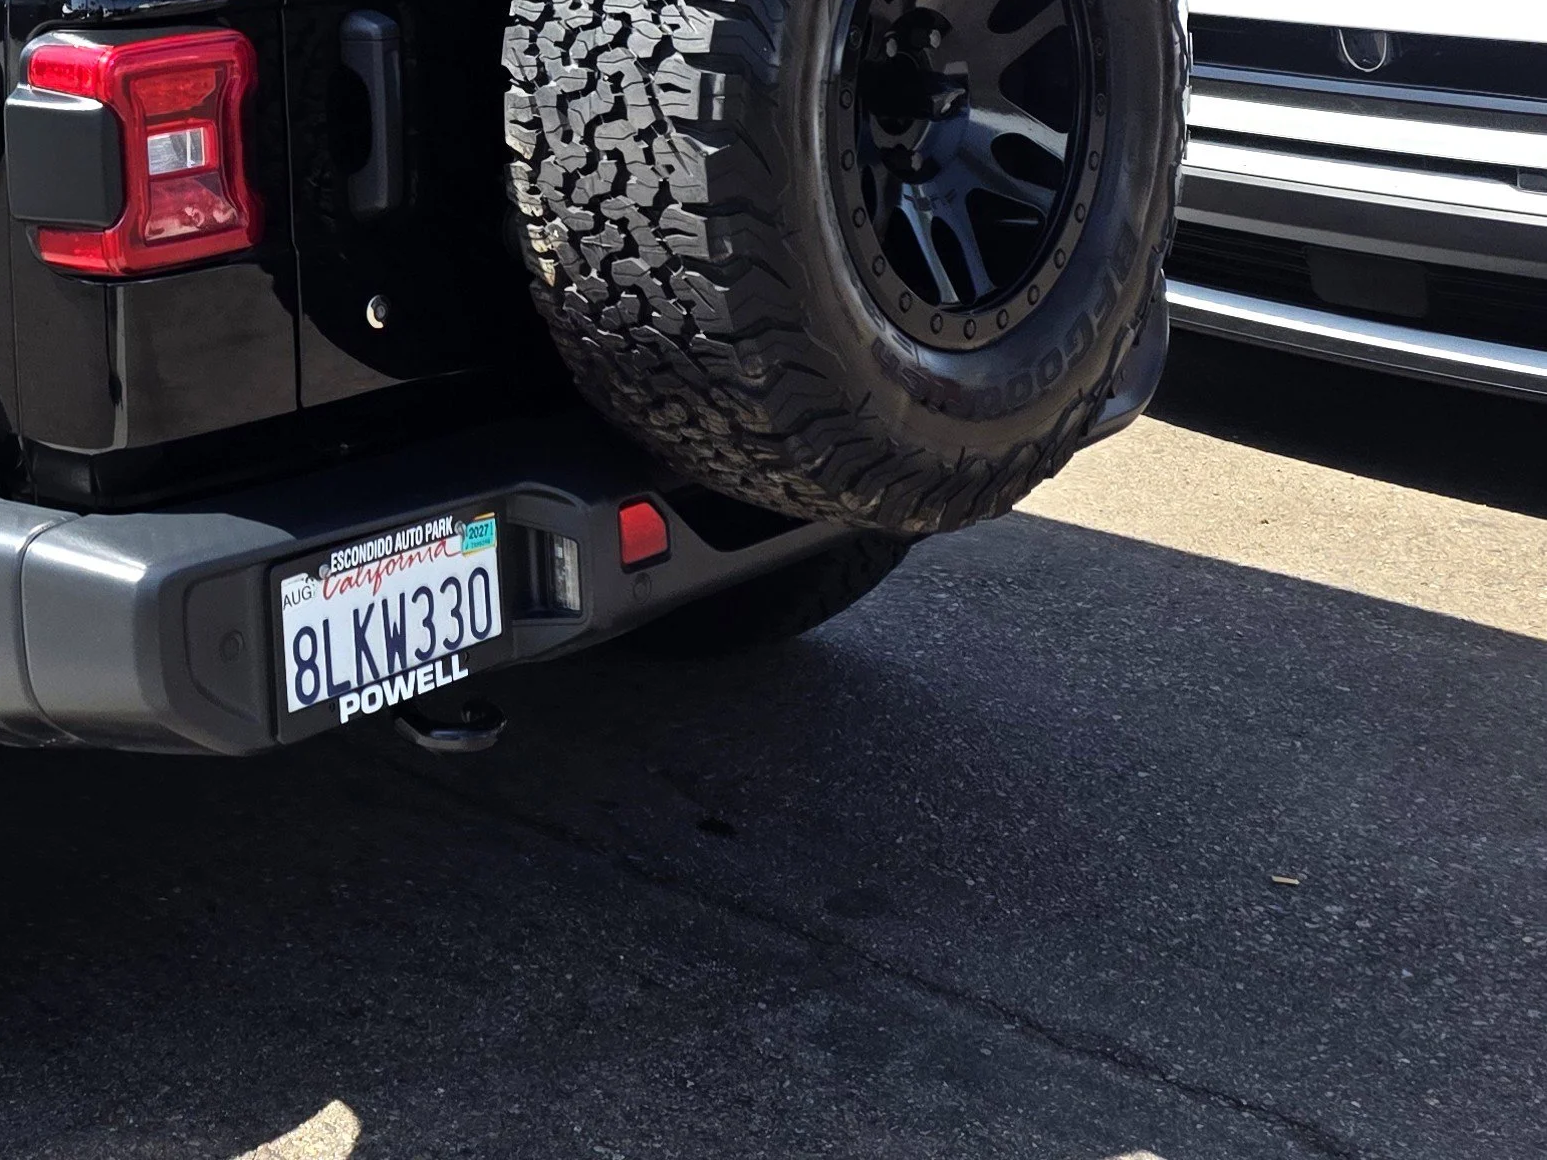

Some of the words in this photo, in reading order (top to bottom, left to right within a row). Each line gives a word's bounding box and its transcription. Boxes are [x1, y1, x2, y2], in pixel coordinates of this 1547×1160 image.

[330, 534, 393, 573] ESCONDIDO
[394, 525, 423, 552] AUTO
[425, 515, 454, 542] PARK
[468, 523, 489, 540] 2027
[282, 582, 313, 610] AUG
[322, 539, 461, 600] California
[292, 566, 493, 705] 8LKW330
[338, 653, 469, 724] POWELL
